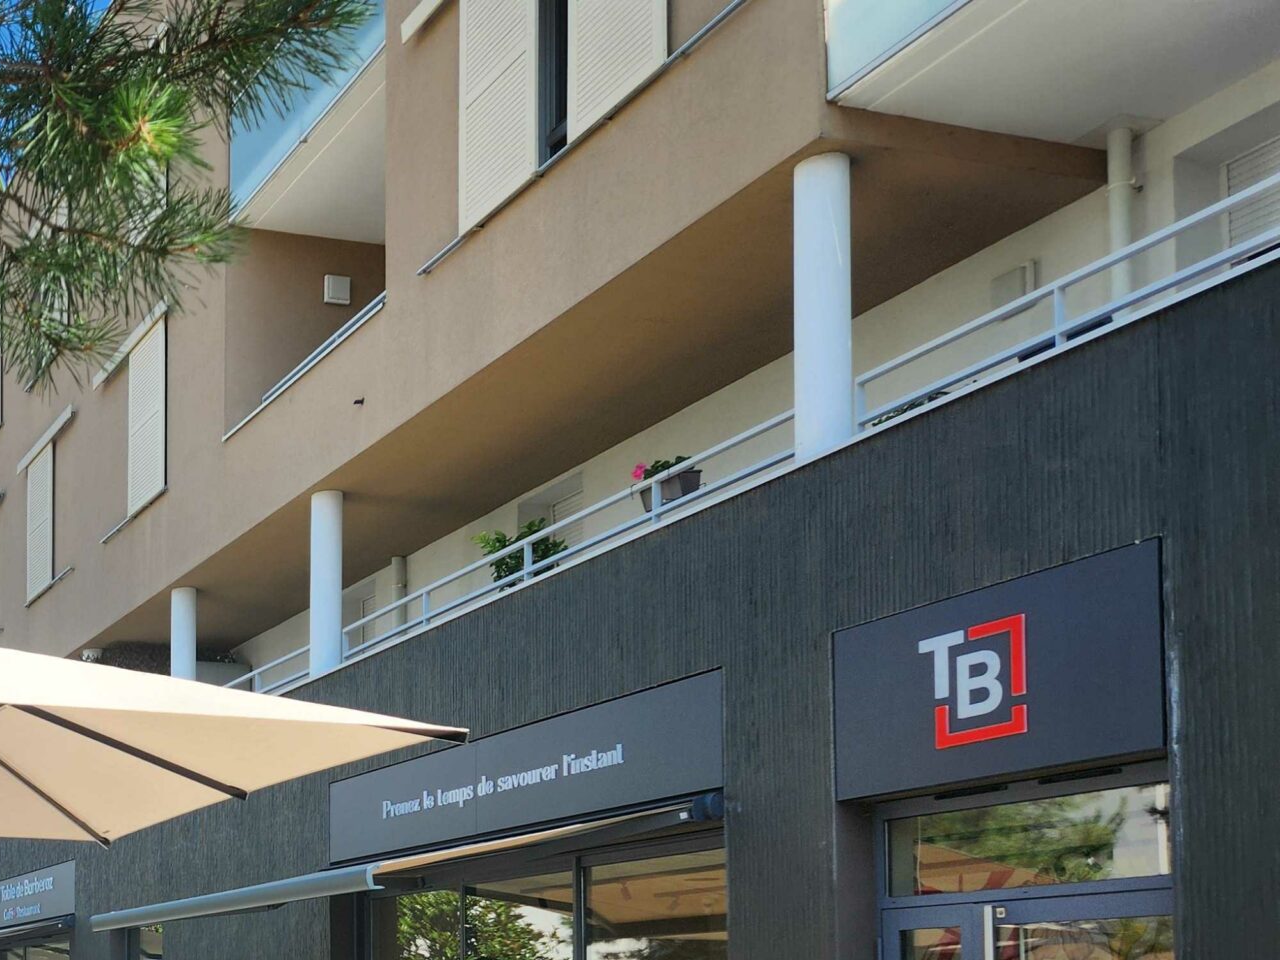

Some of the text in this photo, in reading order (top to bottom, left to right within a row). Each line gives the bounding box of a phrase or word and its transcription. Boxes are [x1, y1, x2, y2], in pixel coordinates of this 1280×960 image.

[918, 629, 1003, 720] TB
[382, 743, 624, 820] Prenez le temps de savourer l'instant
[1, 883, 16, 902] Table
[16, 881, 24, 898] de
[24, 877, 54, 895] Barberaz
